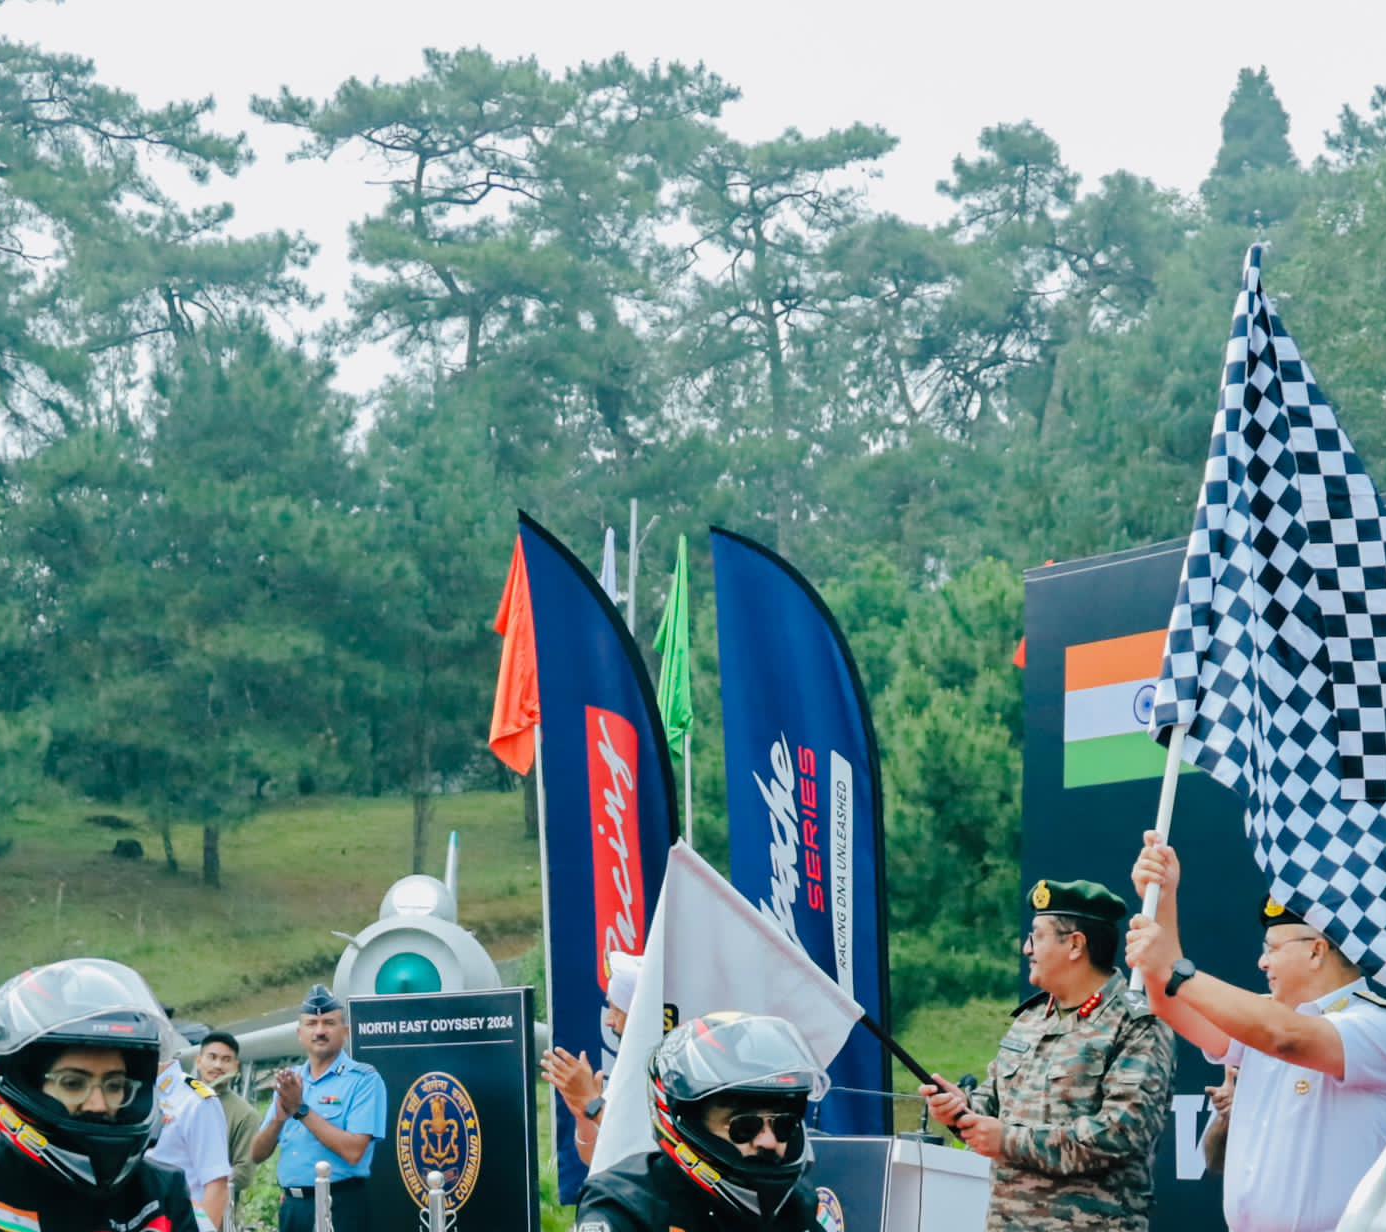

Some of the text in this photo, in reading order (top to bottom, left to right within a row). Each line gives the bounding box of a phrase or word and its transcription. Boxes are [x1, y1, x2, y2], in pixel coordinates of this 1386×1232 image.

[752, 730, 805, 950] pache
[798, 745, 825, 913] SERIES
[836, 780, 848, 970] RACING DNA UNLEASHED
[359, 1015, 514, 1035] NORTH EAST ODYSSEY 2024
[399, 1135, 423, 1199] EASTERN
[456, 1135, 479, 1200] COMMAND
